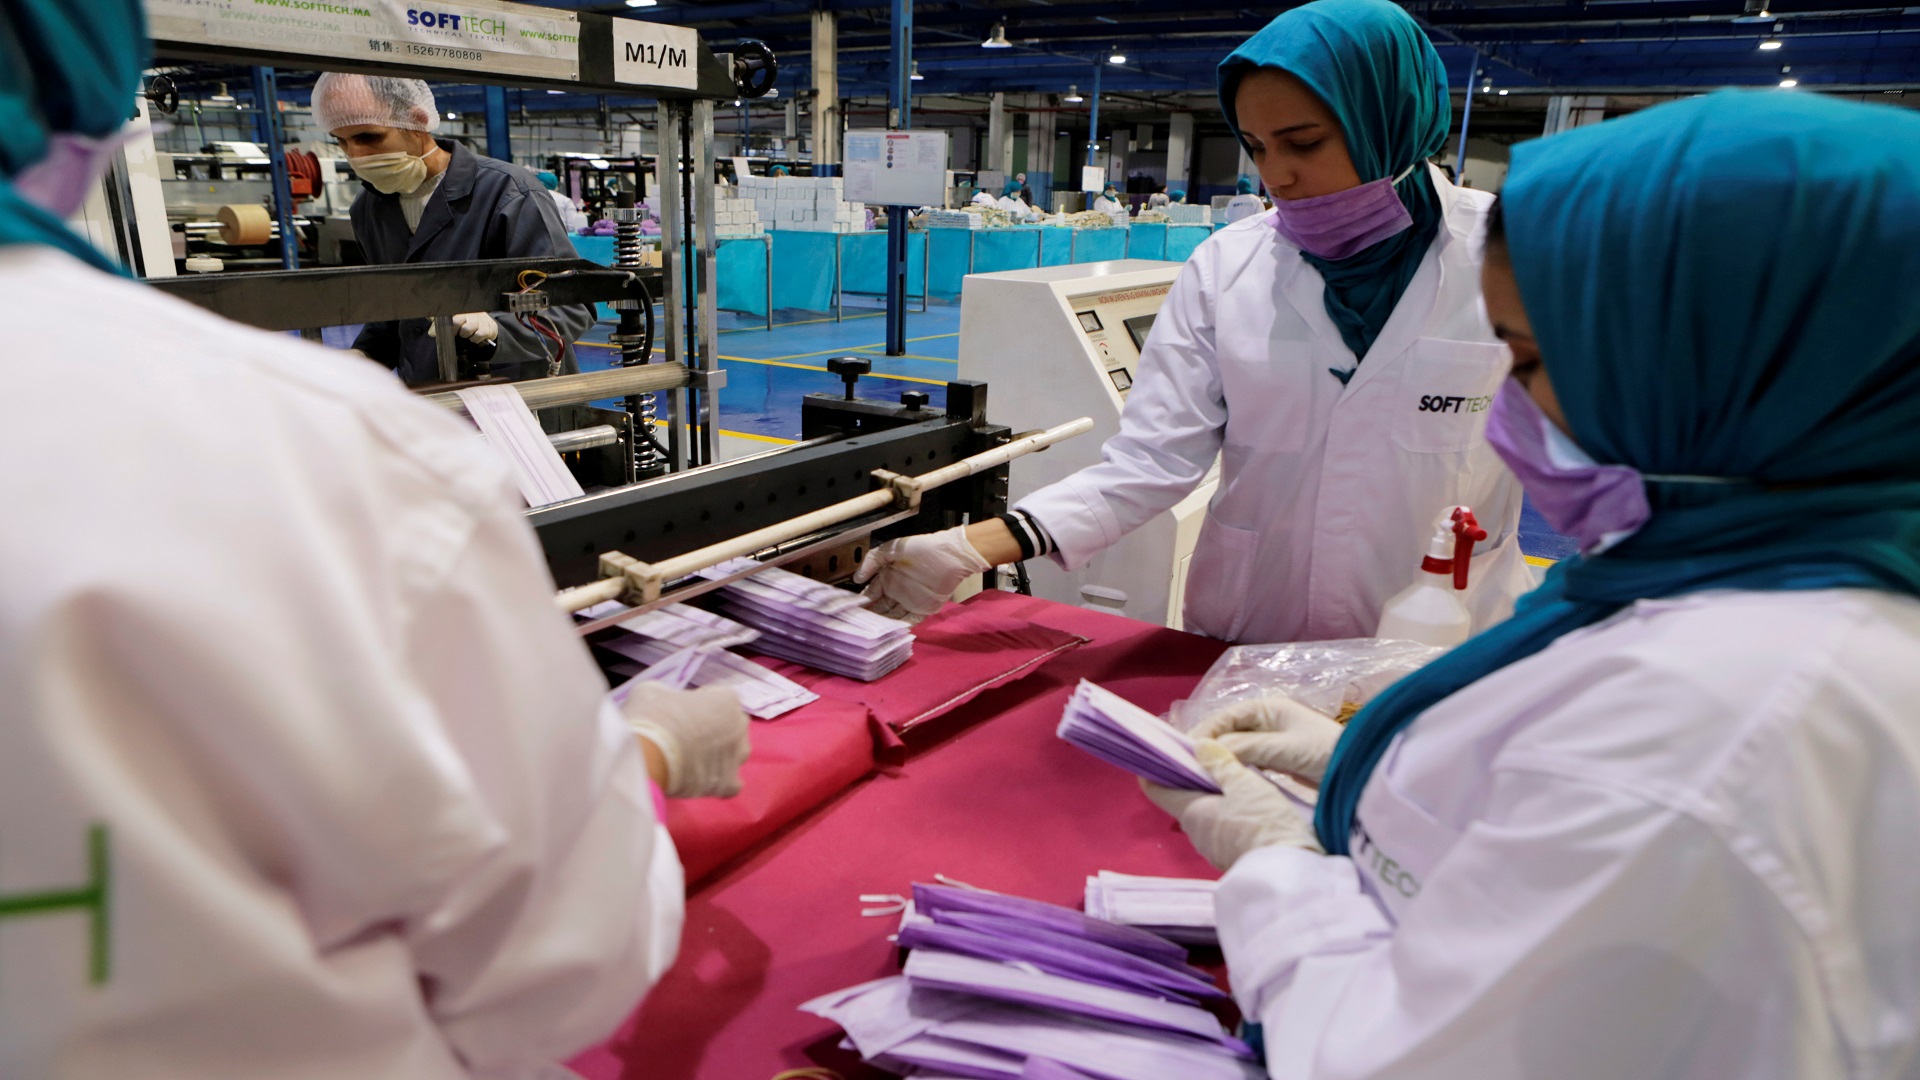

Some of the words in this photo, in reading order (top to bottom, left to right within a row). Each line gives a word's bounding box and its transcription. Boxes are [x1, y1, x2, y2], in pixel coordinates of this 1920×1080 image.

[407, 9, 505, 36] SOFTTECH
[408, 26, 463, 38] TECHNICAL
[469, 33, 505, 43] TEXTILE
[520, 29, 579, 43] WWW.SOFTTE
[407, 44, 482, 61] 15267780808
[625, 42, 687, 69] M1/M
